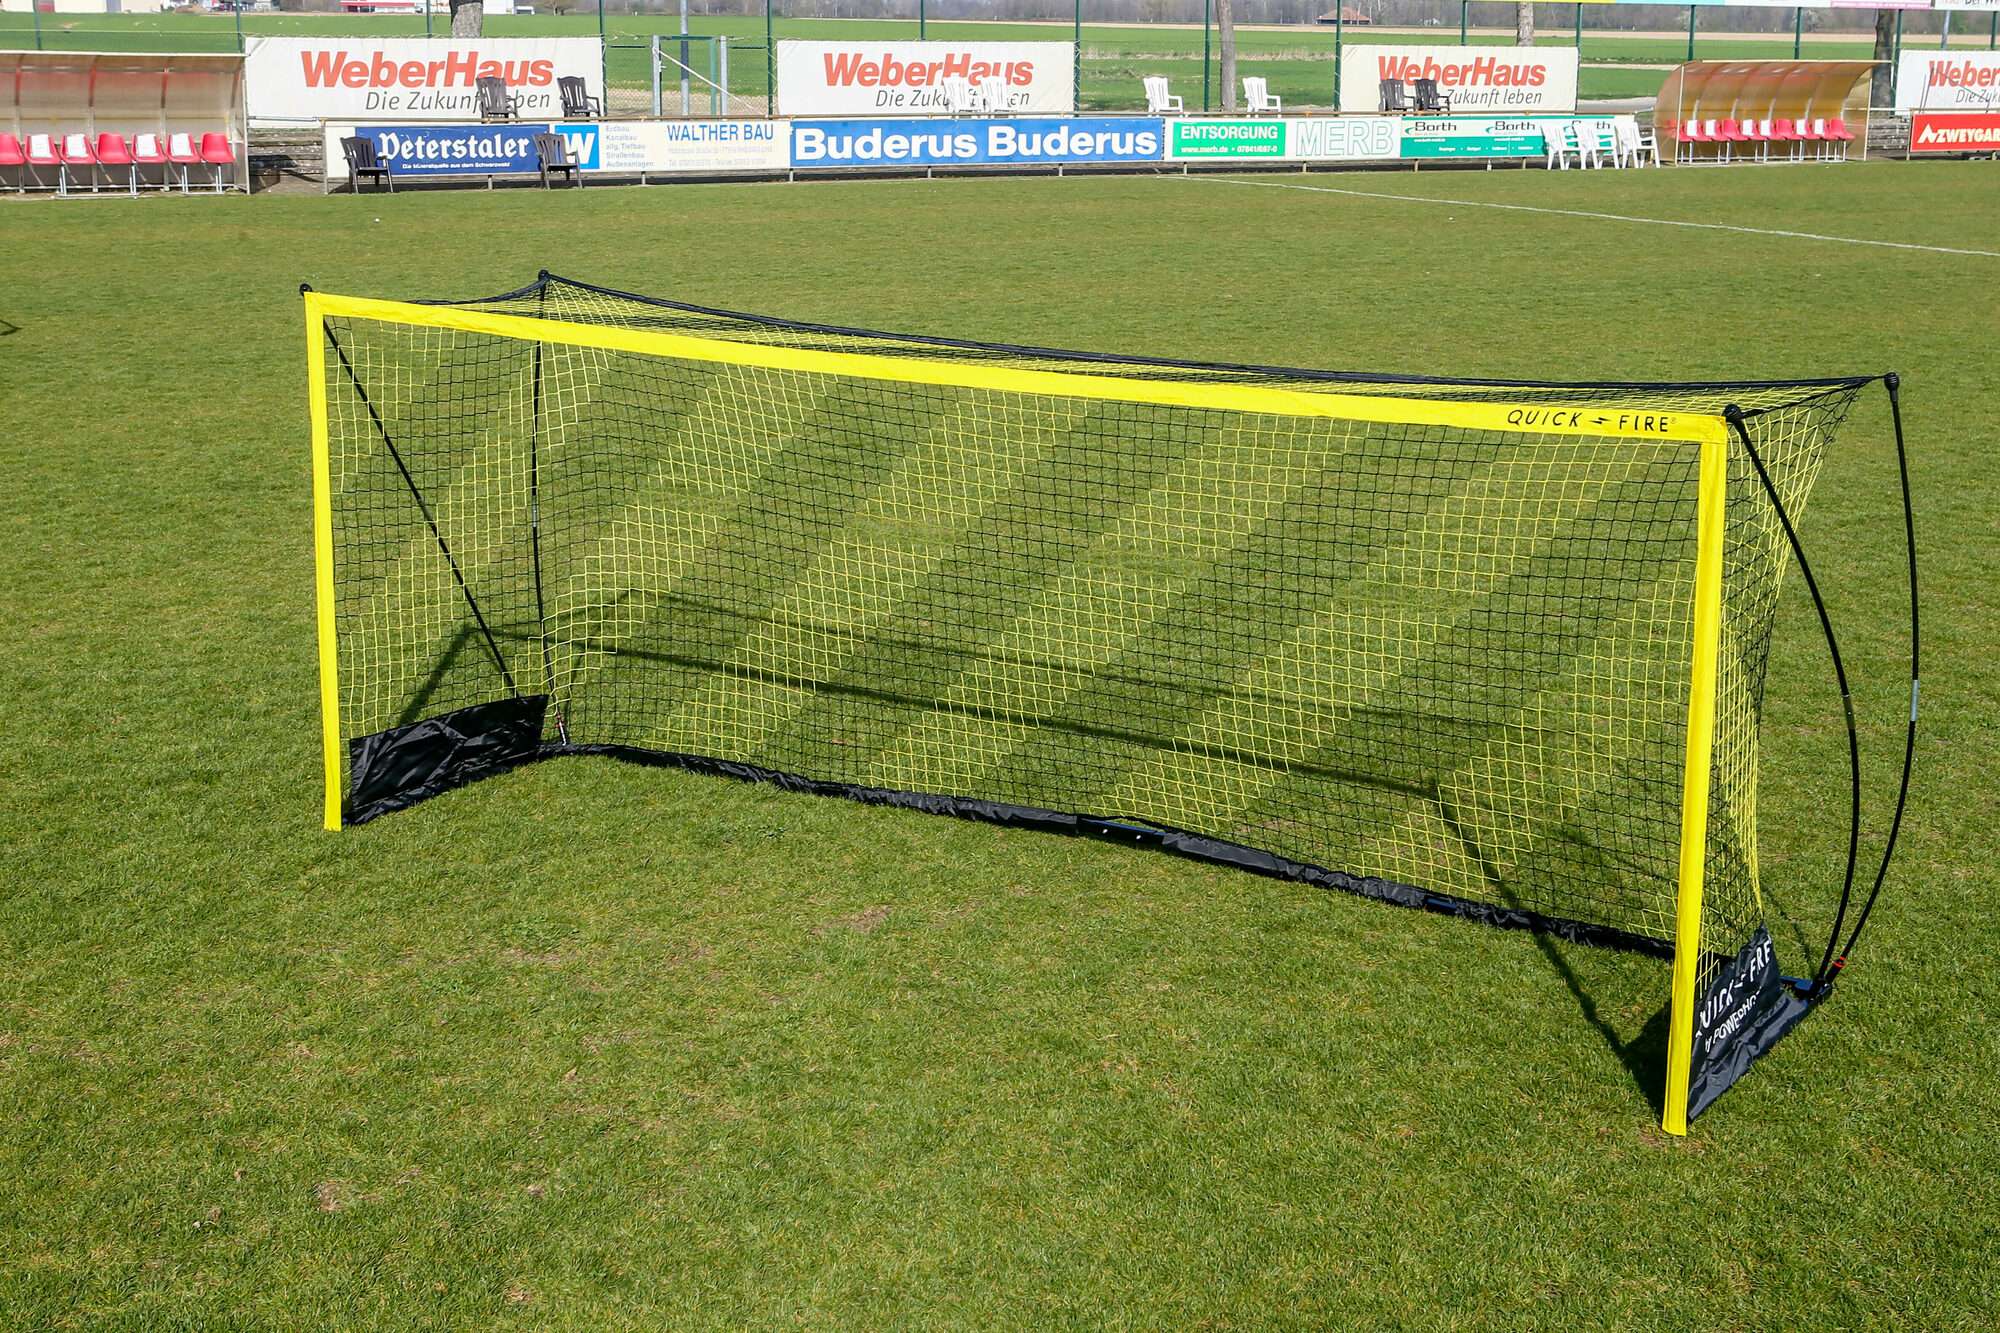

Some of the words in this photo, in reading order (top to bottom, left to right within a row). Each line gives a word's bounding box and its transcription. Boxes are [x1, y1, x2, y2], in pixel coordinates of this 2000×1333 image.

[301, 51, 554, 88] WeberHaus
[823, 53, 1034, 86] WeberHaus
[1378, 56, 1546, 87] WeberHaus
[366, 92, 399, 110] Die
[407, 91, 482, 113] Zukunf
[876, 90, 904, 106] Die
[1447, 89, 1500, 107] Zukunft
[1504, 89, 1542, 105] leben
[667, 124, 739, 141] WALTHER
[743, 123, 774, 140] BAU
[1181, 125, 1278, 139] ENTSORGUNG
[1415, 121, 1457, 131] Barth
[1495, 120, 1536, 130] Barth
[378, 133, 529, 162] Peterstaler
[795, 128, 977, 161] Buderus
[988, 125, 1158, 158] Buderus
[1296, 120, 1394, 156] MERB
[1507, 409, 1583, 427] QUICK
[1696, 979, 1734, 1037] UICK
